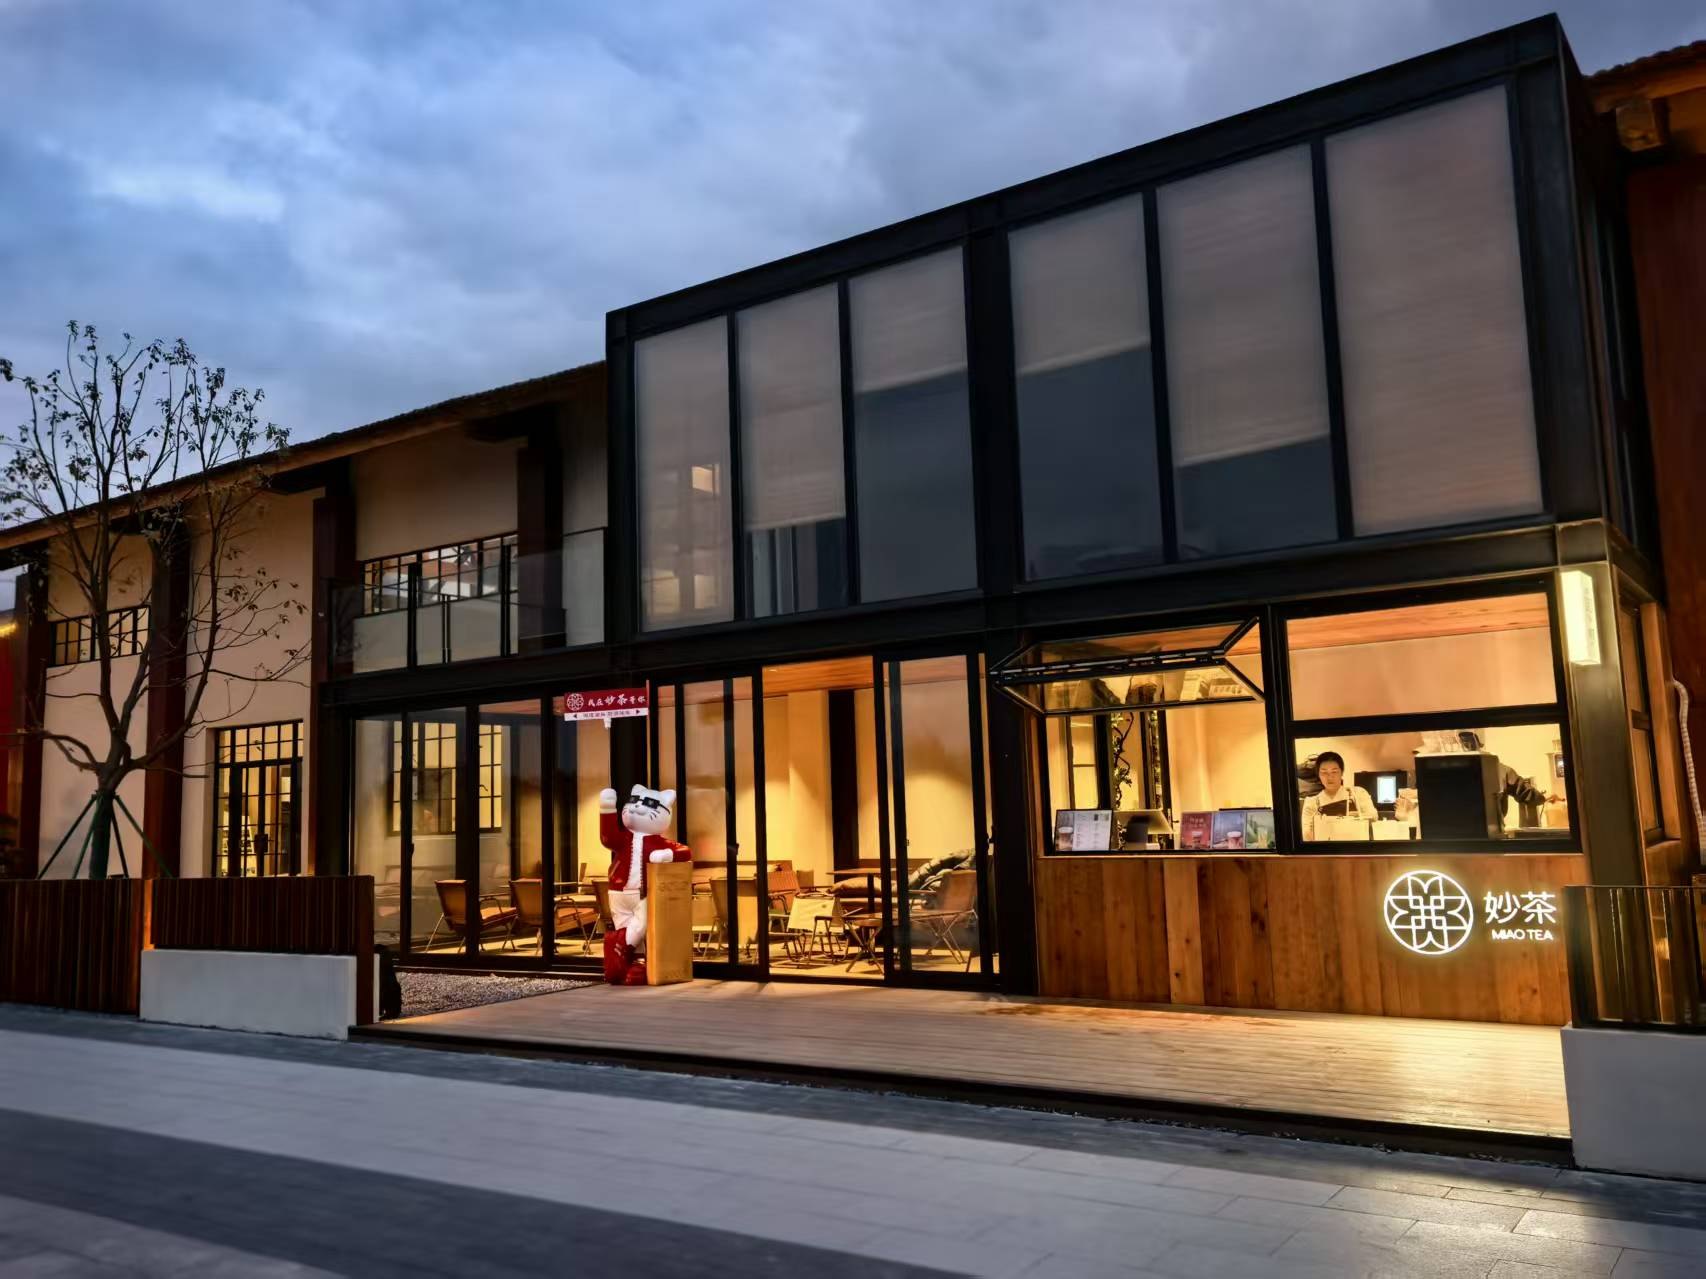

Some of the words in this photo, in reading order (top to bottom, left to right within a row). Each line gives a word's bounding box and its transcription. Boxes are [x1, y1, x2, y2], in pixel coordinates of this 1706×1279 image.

[1483, 891, 1557, 924] 妙茶
[1491, 928, 1526, 941] MIAO
[1526, 929, 1554, 941] TEA
